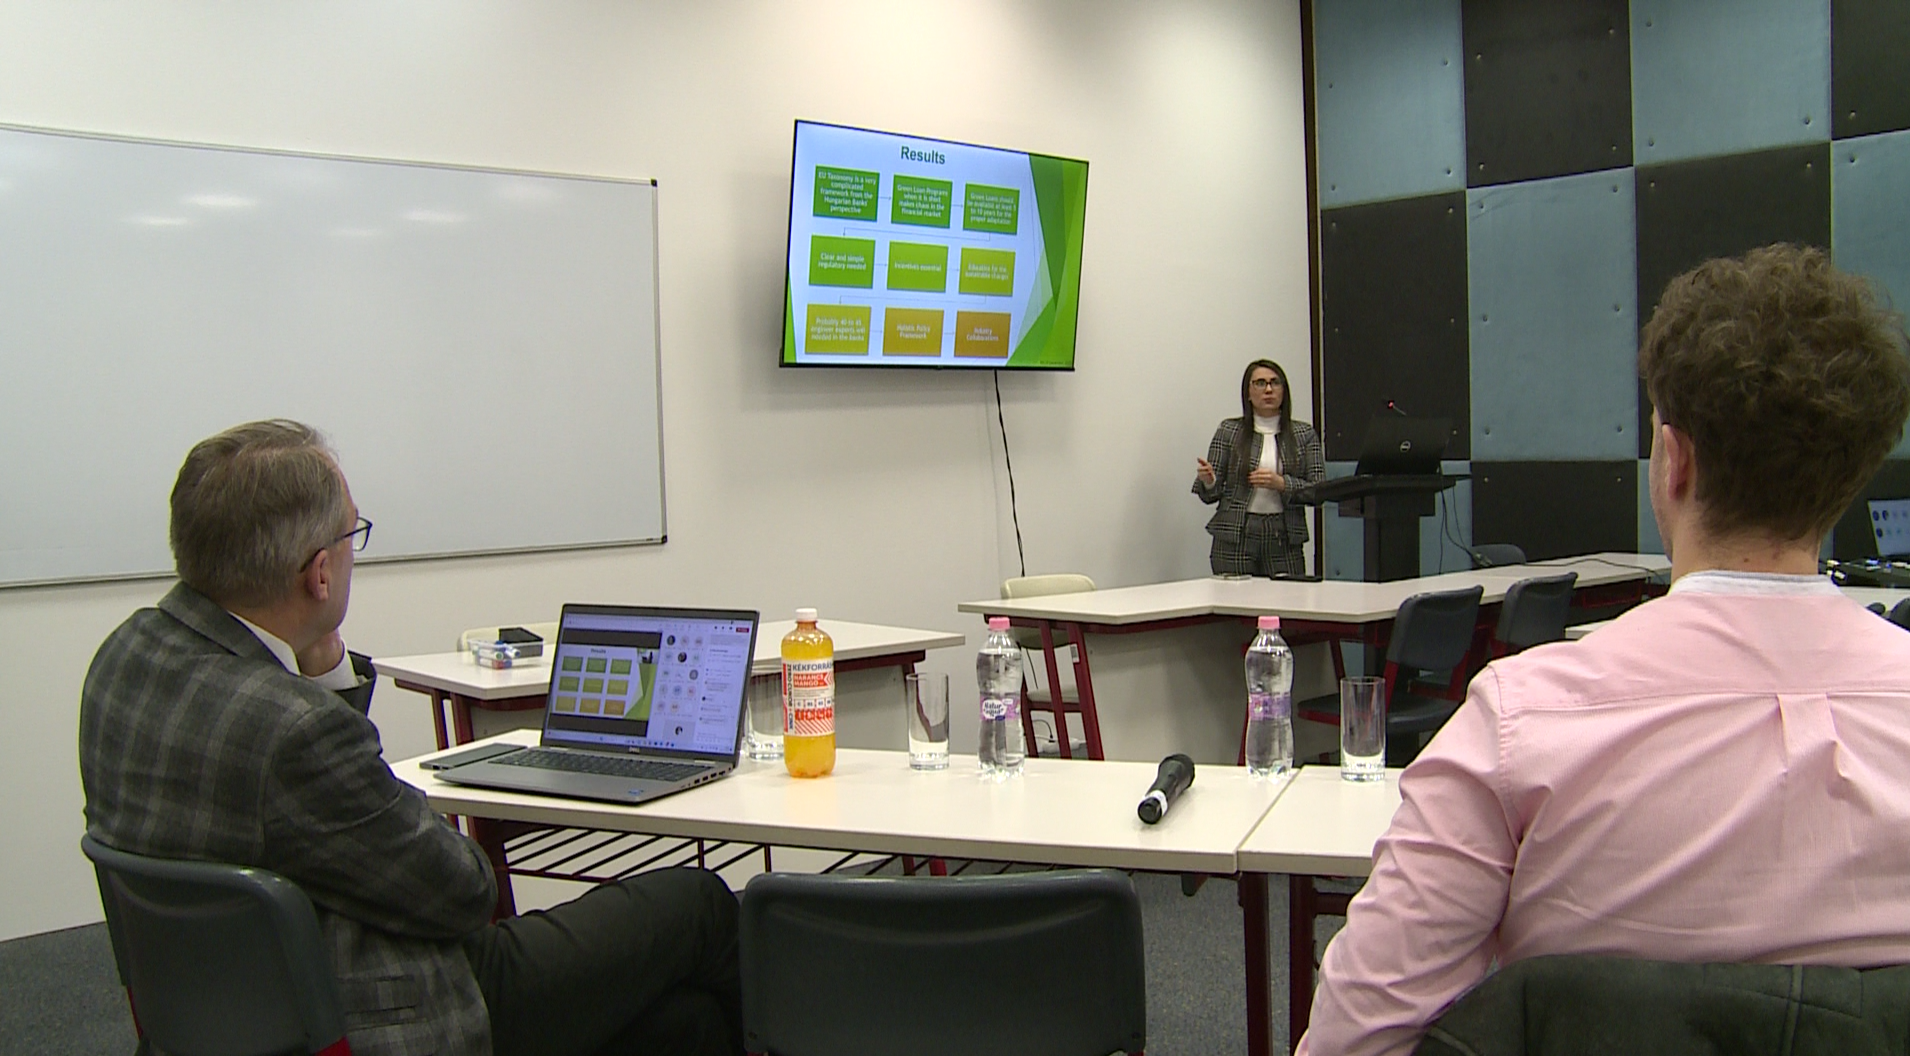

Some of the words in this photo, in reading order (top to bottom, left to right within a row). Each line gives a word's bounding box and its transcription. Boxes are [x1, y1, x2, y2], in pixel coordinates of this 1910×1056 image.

[900, 145, 945, 164] Results
[826, 172, 852, 182] Taxonomy
[865, 177, 876, 185] very
[830, 180, 863, 191] complicated
[897, 184, 912, 192] Green
[913, 185, 924, 193] Loan
[820, 186, 848, 196] framework
[850, 190, 862, 198] from
[863, 191, 873, 199] the
[970, 192, 984, 200] Green
[999, 195, 1013, 203] should
[824, 195, 851, 205] Hungarian
[830, 204, 861, 214] perspective
[821, 252, 834, 260] Clear
[847, 254, 864, 263] simple
[818, 259, 845, 270] regulatory
[846, 261, 866, 270] needed
[920, 262, 941, 271] essential
